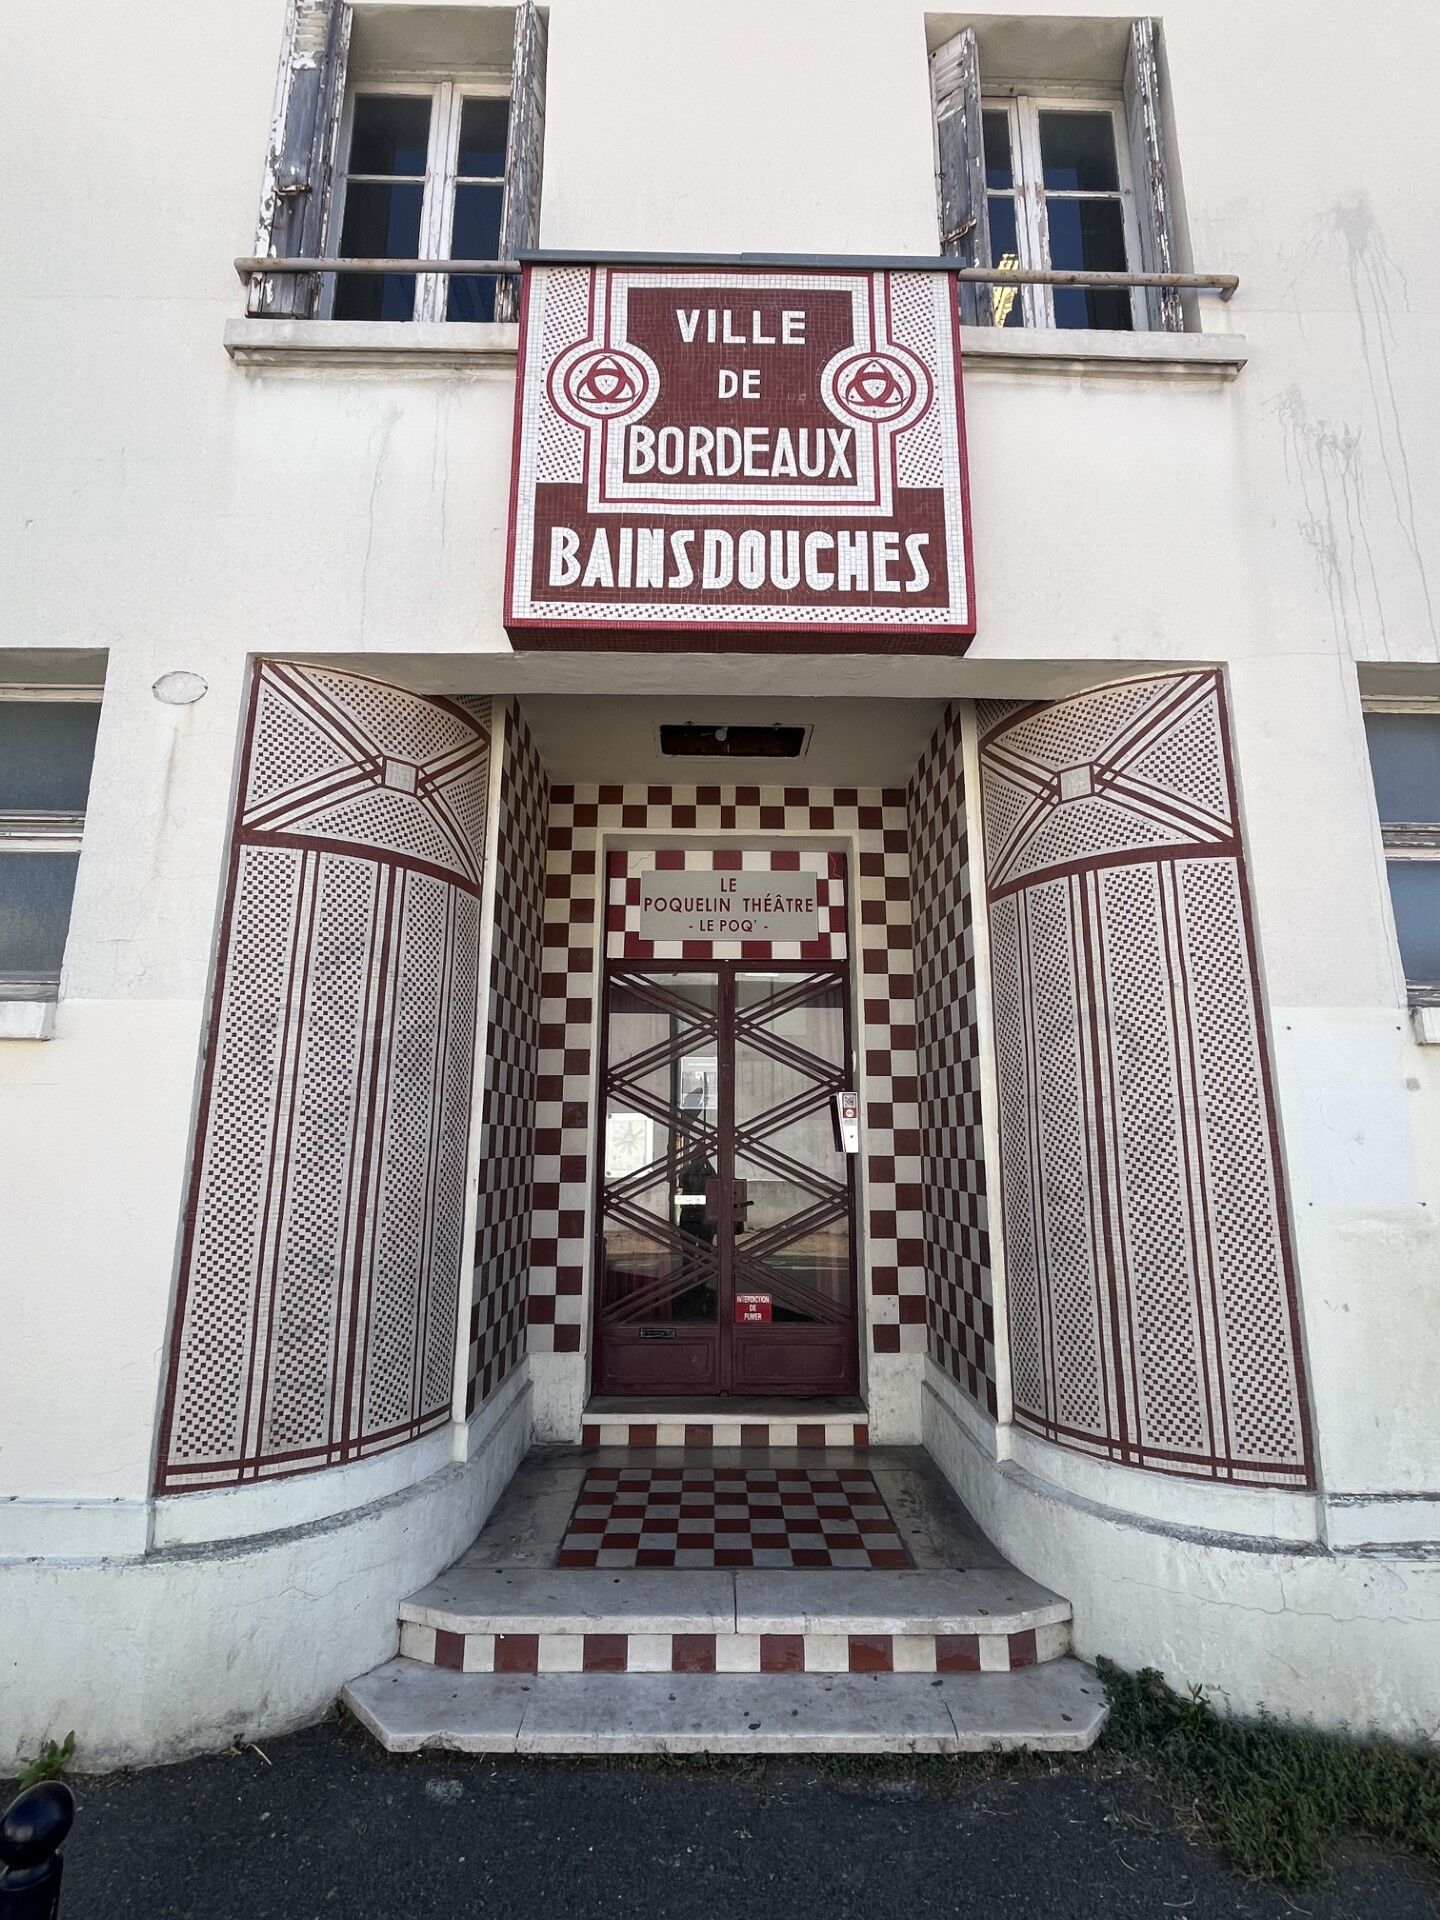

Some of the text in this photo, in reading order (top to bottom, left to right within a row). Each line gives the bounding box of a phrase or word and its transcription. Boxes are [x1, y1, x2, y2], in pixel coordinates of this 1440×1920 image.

[676, 309, 806, 345] VILLE
[718, 369, 761, 399] DE
[628, 425, 853, 479] BORDEAUX
[720, 878, 737, 893] LE
[644, 894, 814, 913] POQUELIN THÉÂTRE
[699, 920, 714, 932] LE
[736, 1295, 770, 1303] INTERDICTION
[744, 1312, 762, 1320] FUMER
